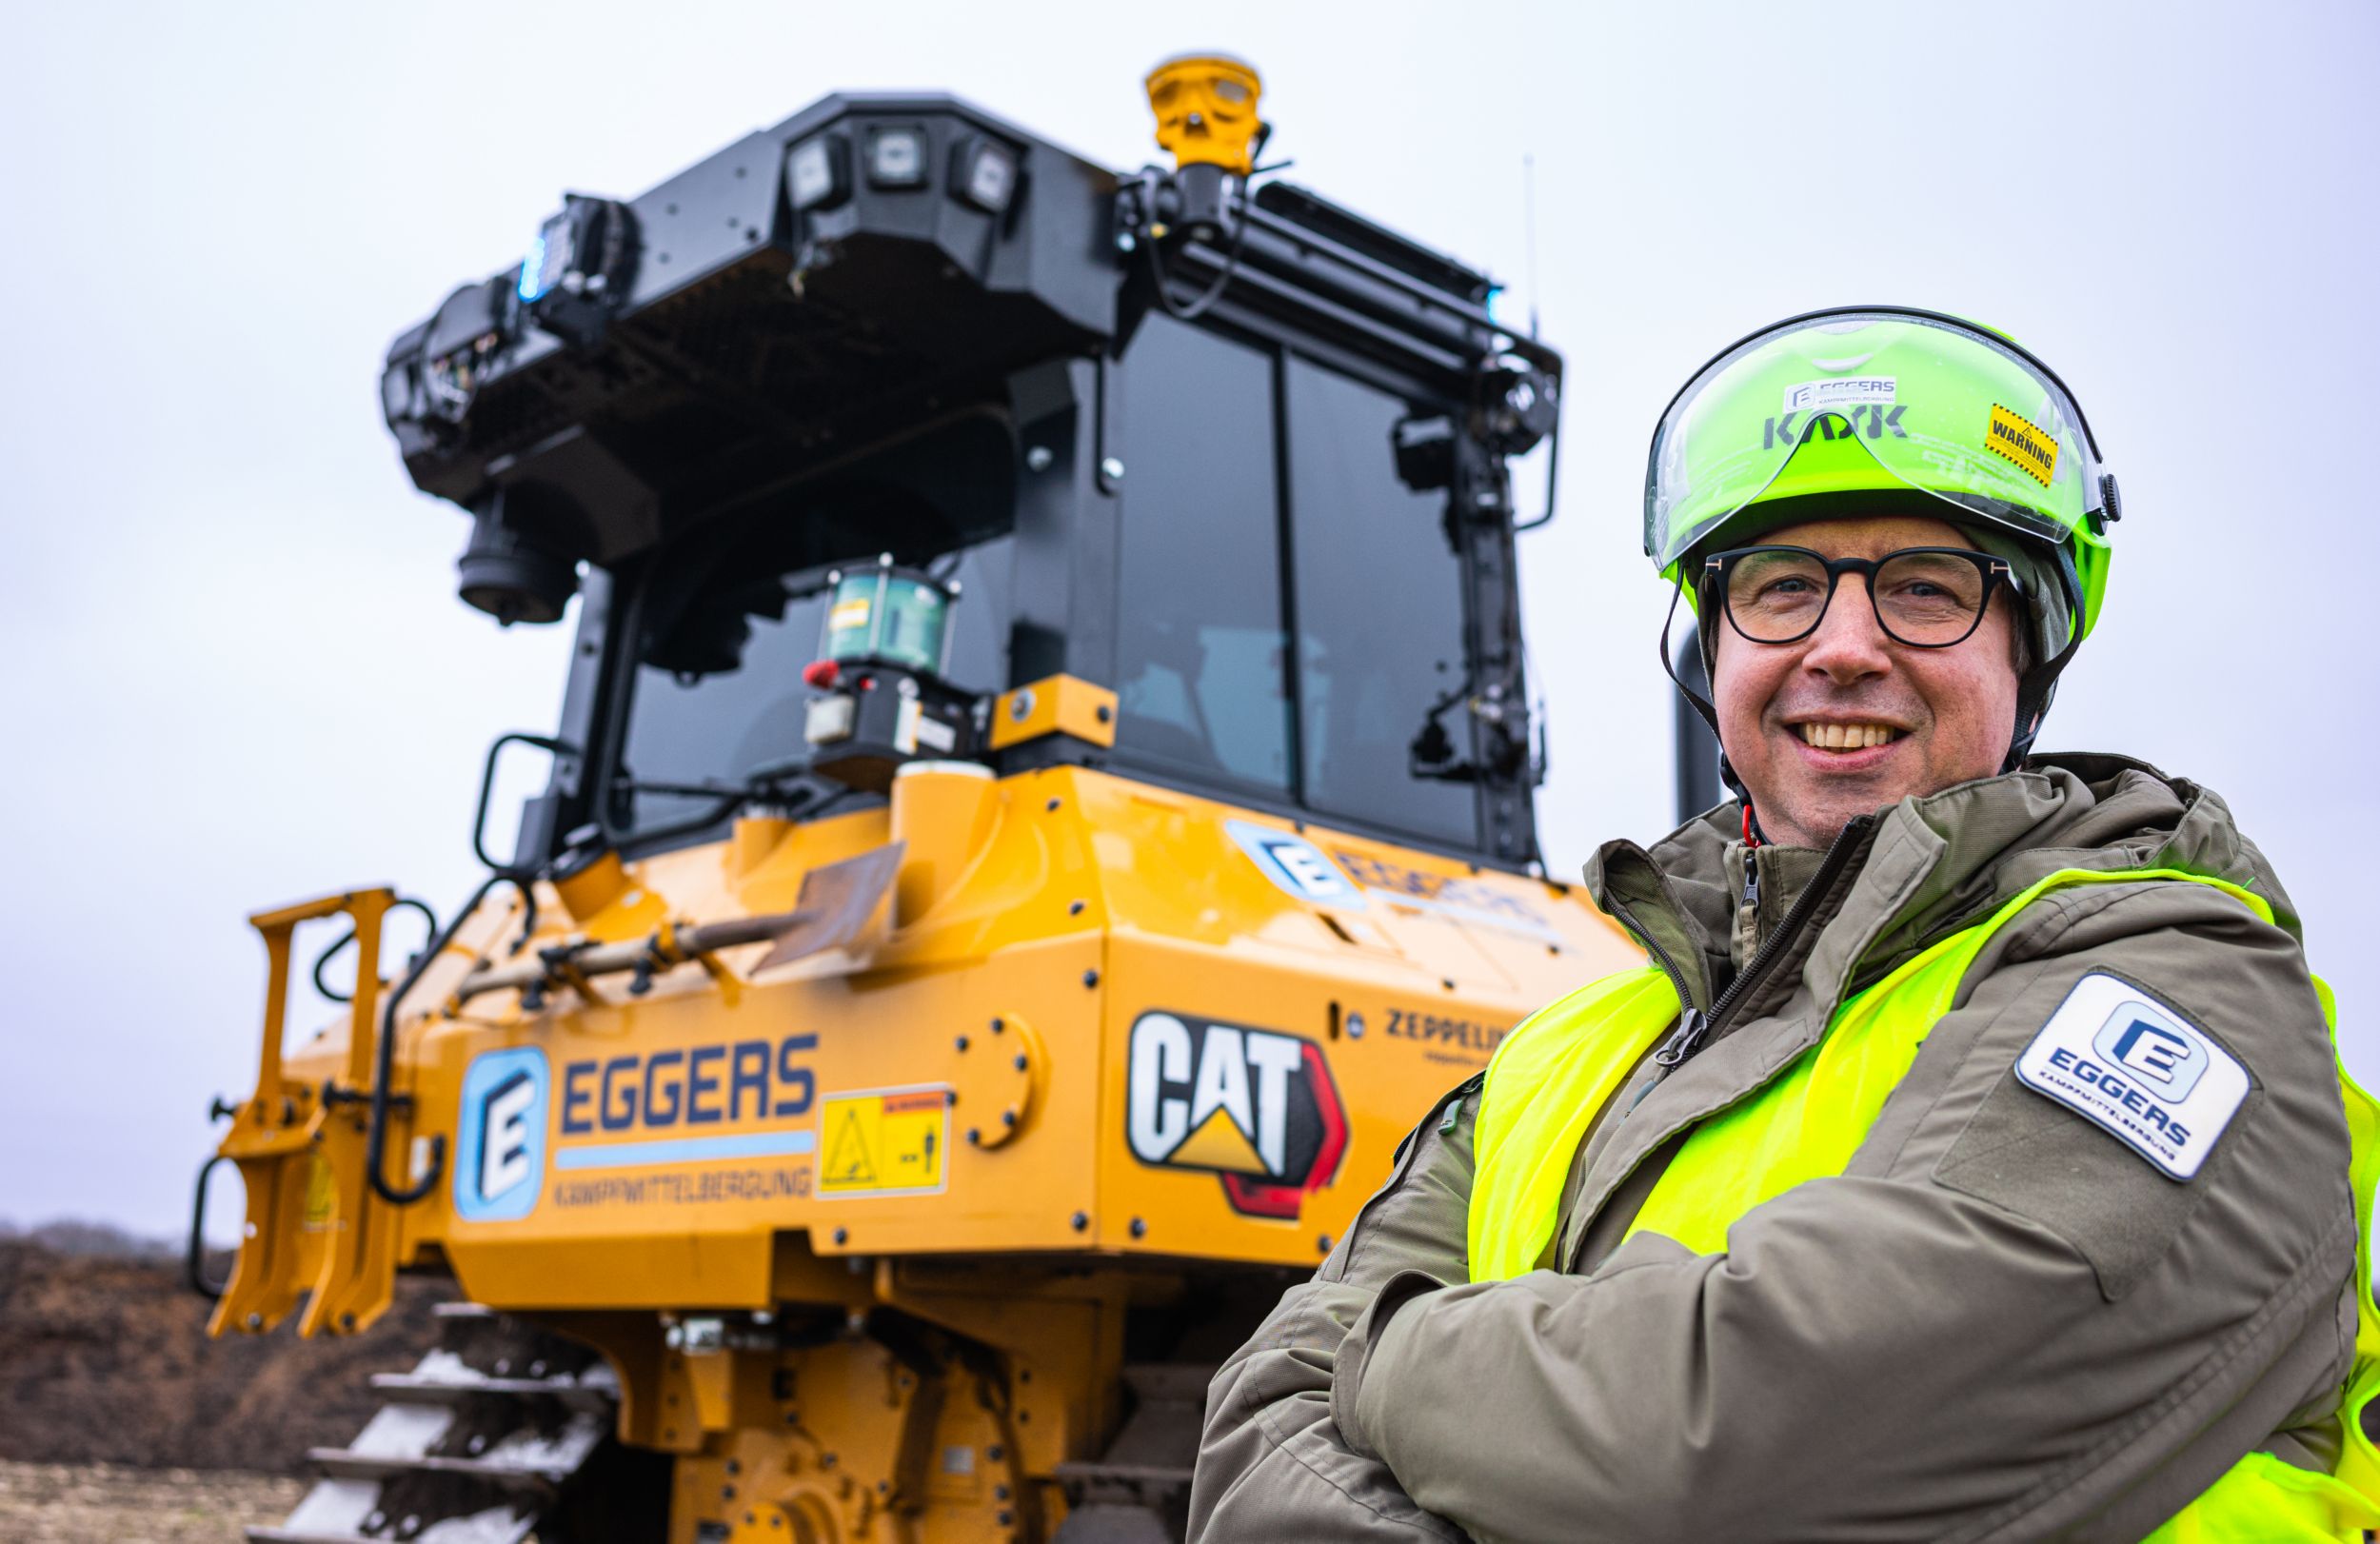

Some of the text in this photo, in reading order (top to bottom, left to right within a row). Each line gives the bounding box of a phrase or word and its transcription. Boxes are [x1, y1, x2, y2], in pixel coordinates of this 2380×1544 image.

[1763, 405, 1908, 450] KASK
[1993, 420, 2053, 470] WARNING
[561, 1033, 819, 1135] EGGERS
[1127, 1013, 1302, 1178] CAT
[2048, 1046, 2192, 1147] EGGERS
[2112, 1019, 2192, 1084] E
[478, 1067, 536, 1203] E
[2038, 1070, 2176, 1161] KAMPFMITTELBERGUNG
